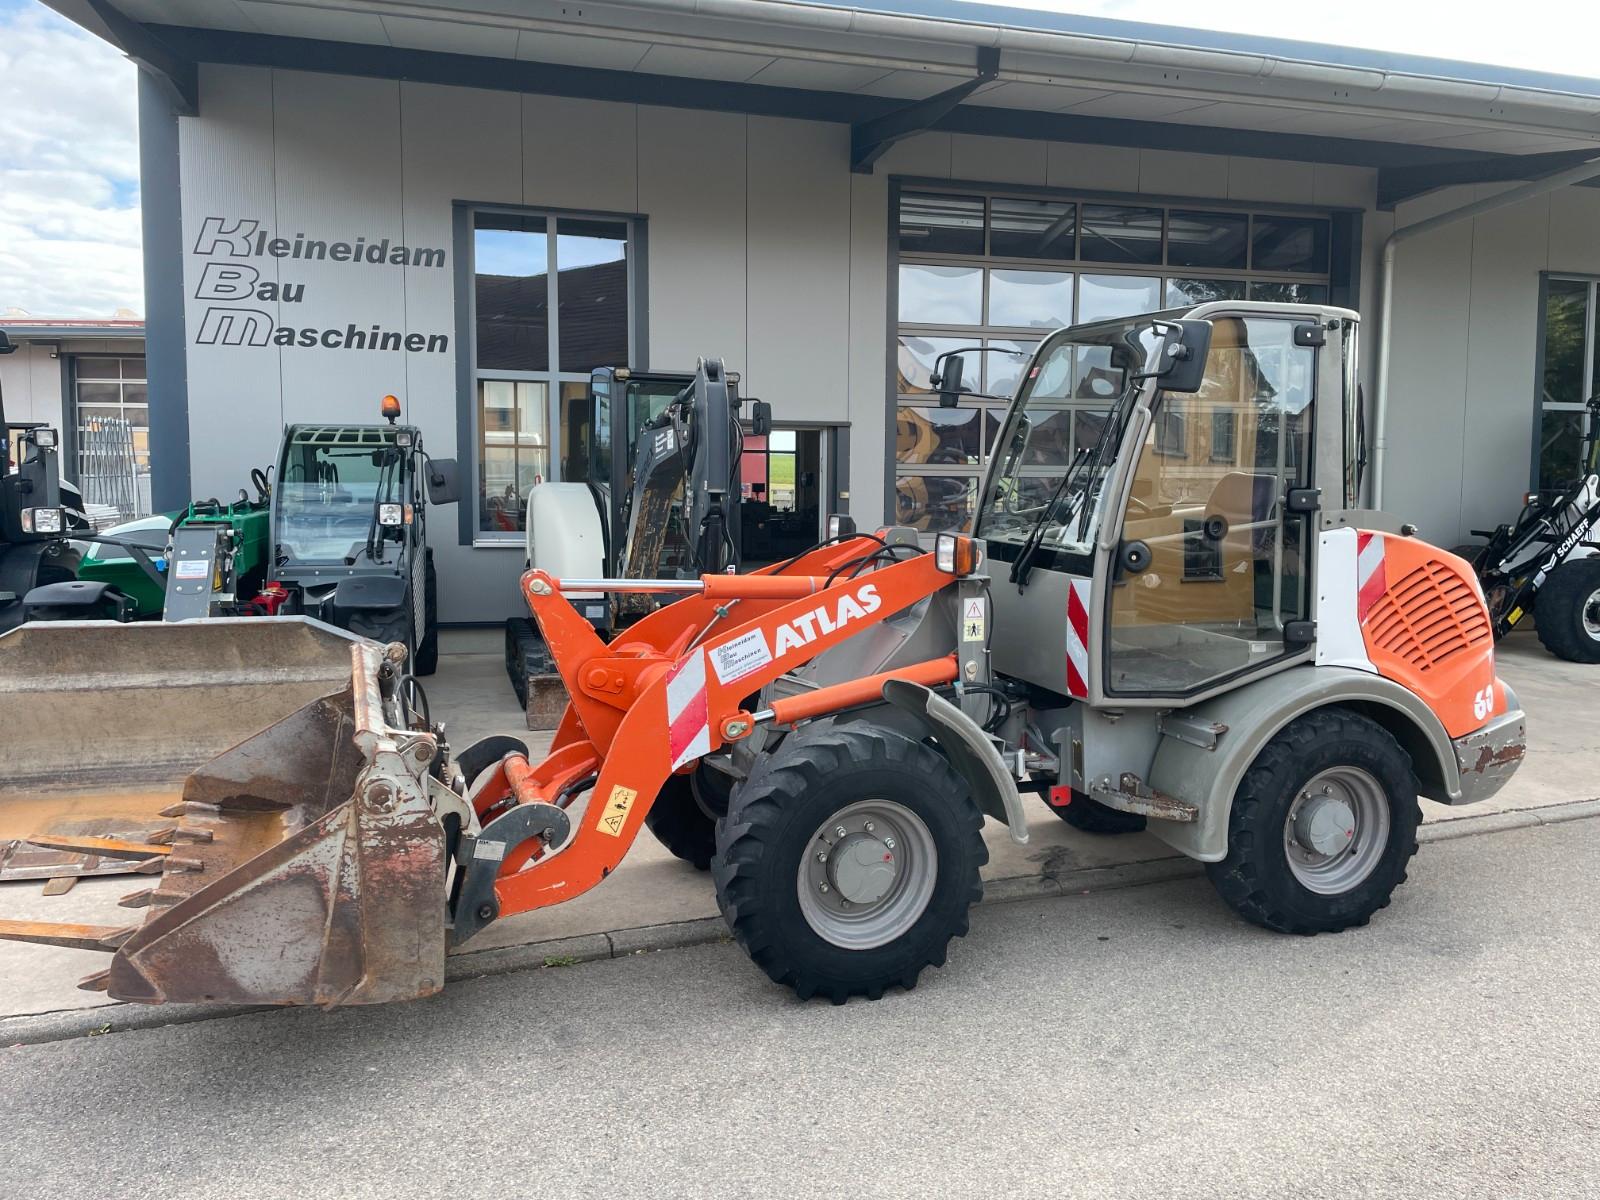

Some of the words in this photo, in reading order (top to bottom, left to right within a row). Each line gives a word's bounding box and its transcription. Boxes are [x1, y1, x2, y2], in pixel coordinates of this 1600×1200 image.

[193, 216, 446, 268] Kleineidam
[194, 262, 305, 303] Bau
[195, 306, 449, 353] Maschinen
[1557, 517, 1589, 557] SCHAEFF
[775, 583, 882, 659] ATLAS
